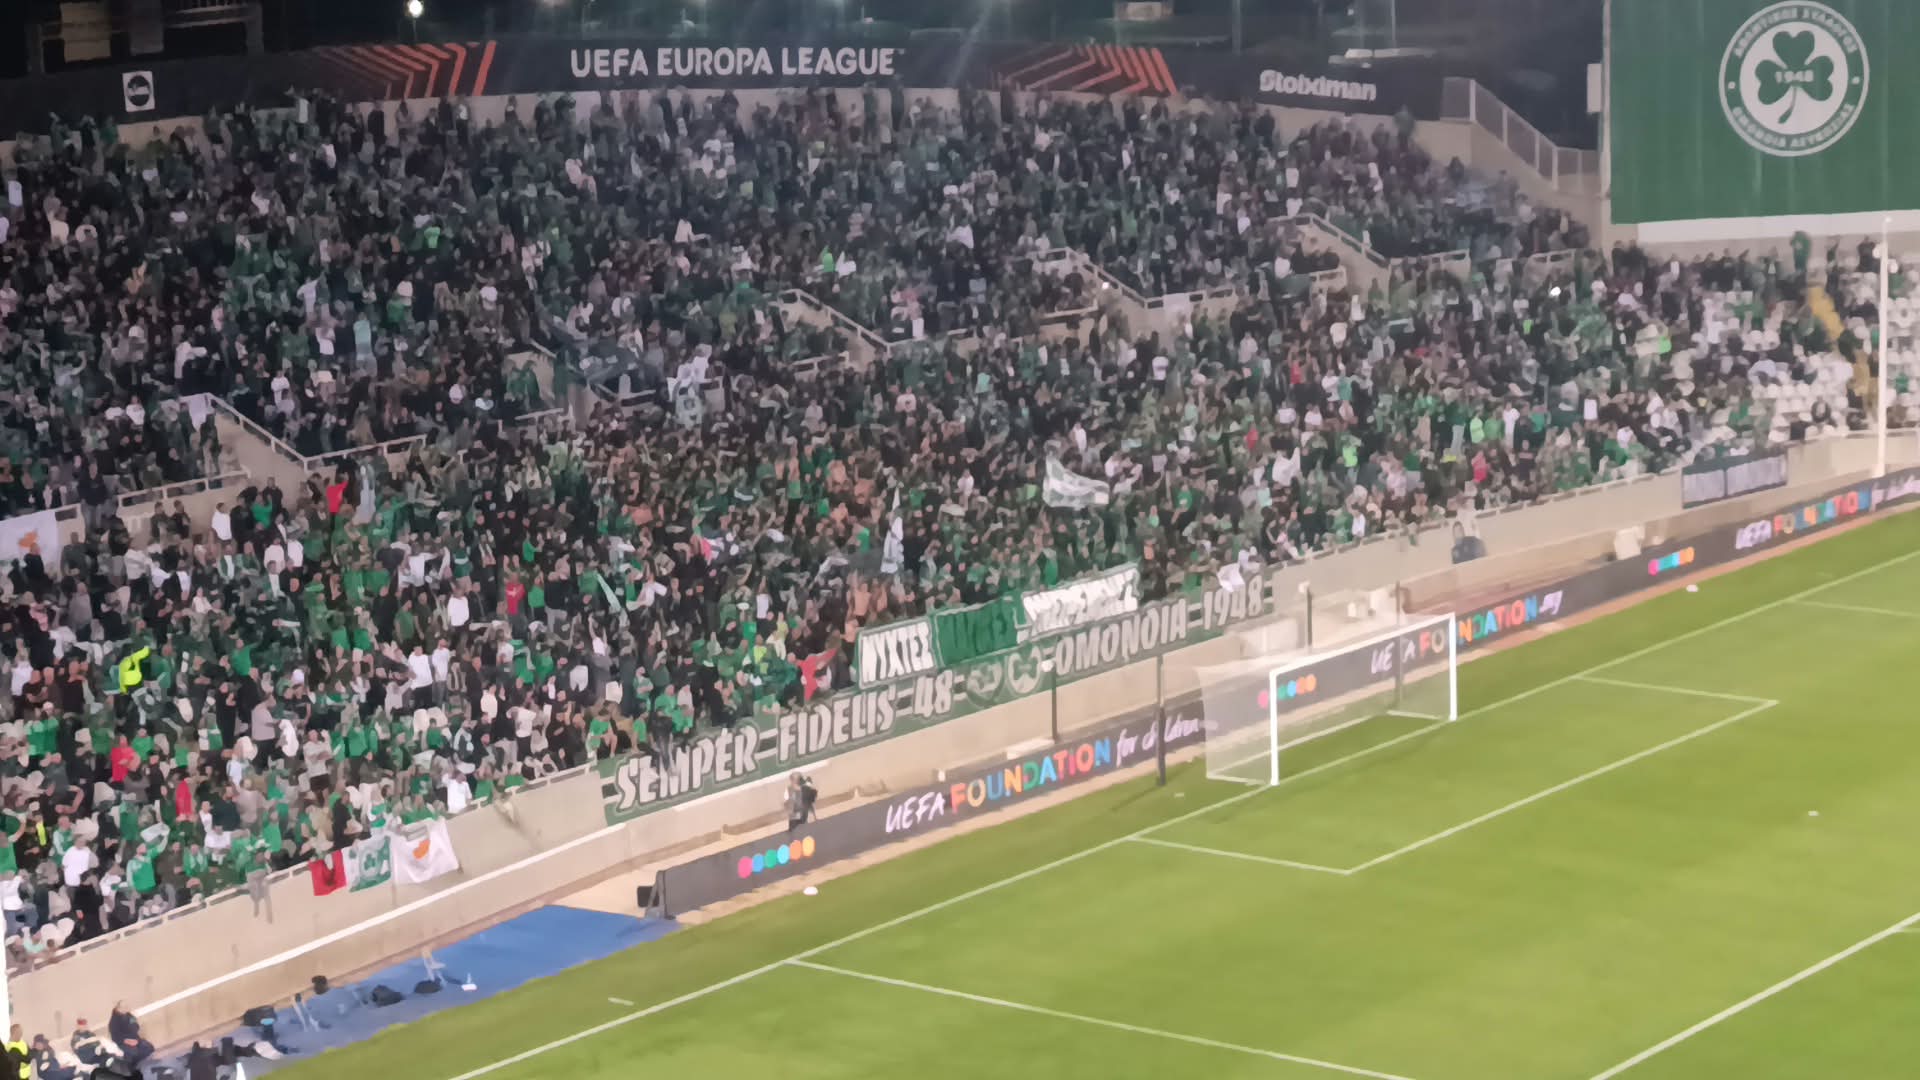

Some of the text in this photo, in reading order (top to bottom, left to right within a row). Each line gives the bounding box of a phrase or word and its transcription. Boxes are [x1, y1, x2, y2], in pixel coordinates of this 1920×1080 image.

[570, 47, 896, 78] UEFA EUROPA LEAGUE
[1371, 640, 1416, 674] UEA
[617, 725, 758, 809] SEMPER
[778, 686, 896, 763] FIDELIS
[913, 670, 953, 718] 48
[885, 791, 946, 833] UEFA
[950, 737, 1112, 814] FOUNDATION
[1116, 728, 1139, 768] for
